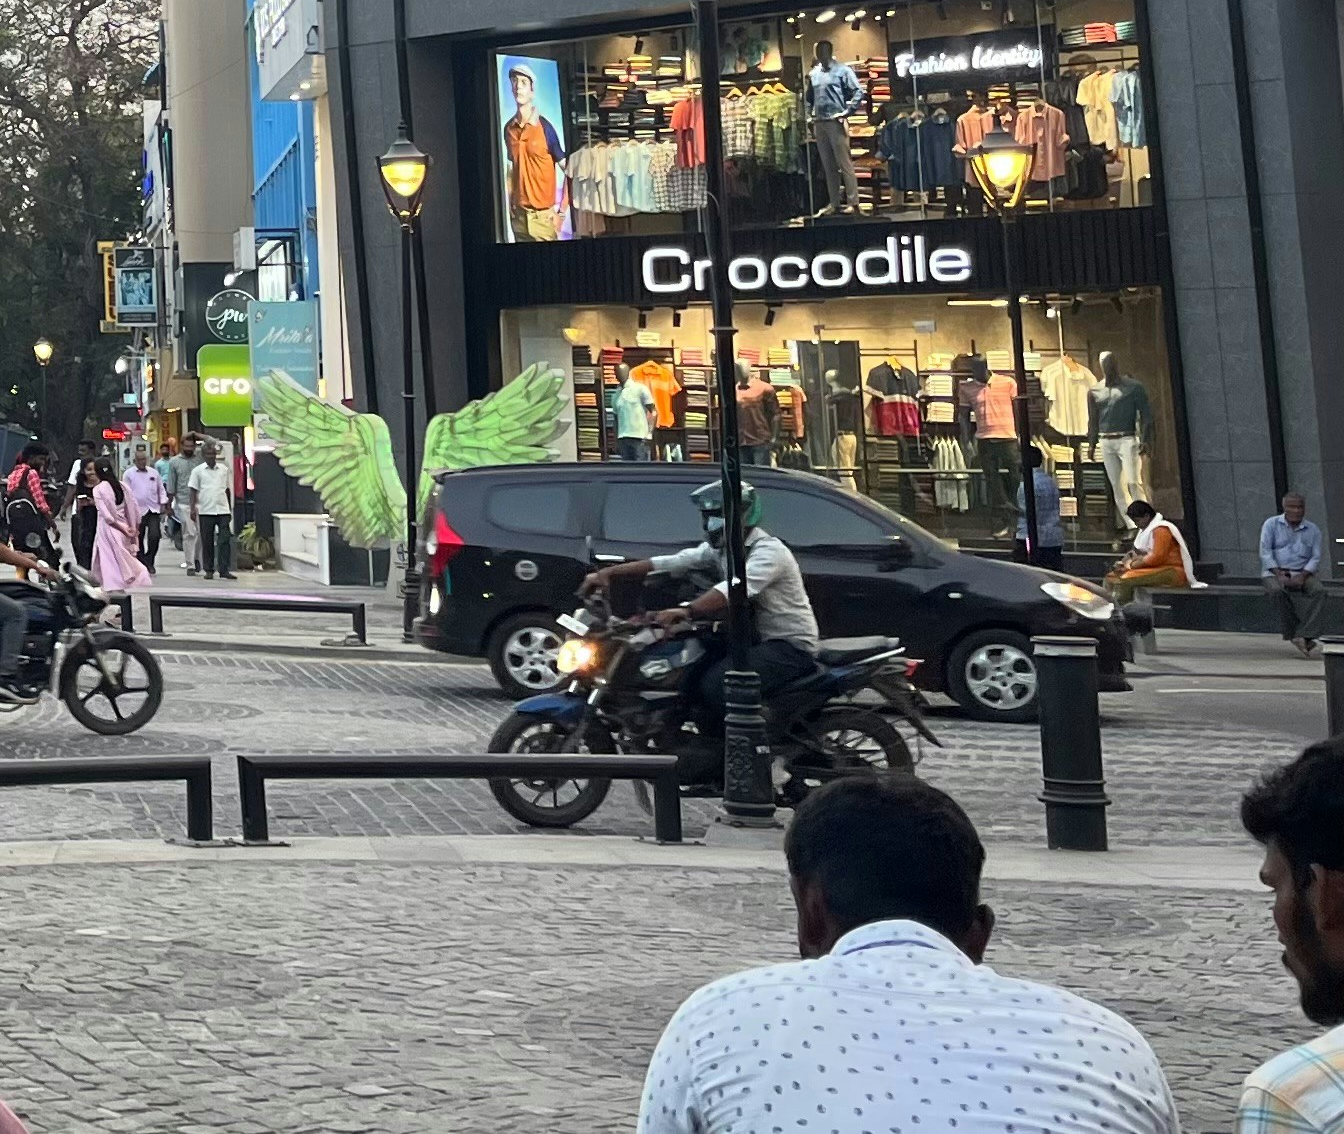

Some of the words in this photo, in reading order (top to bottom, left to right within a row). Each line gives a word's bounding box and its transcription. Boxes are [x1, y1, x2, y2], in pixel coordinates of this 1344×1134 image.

[895, 53, 968, 78] Fashion
[972, 44, 1042, 68] Identity
[641, 235, 972, 293] Crocodile
